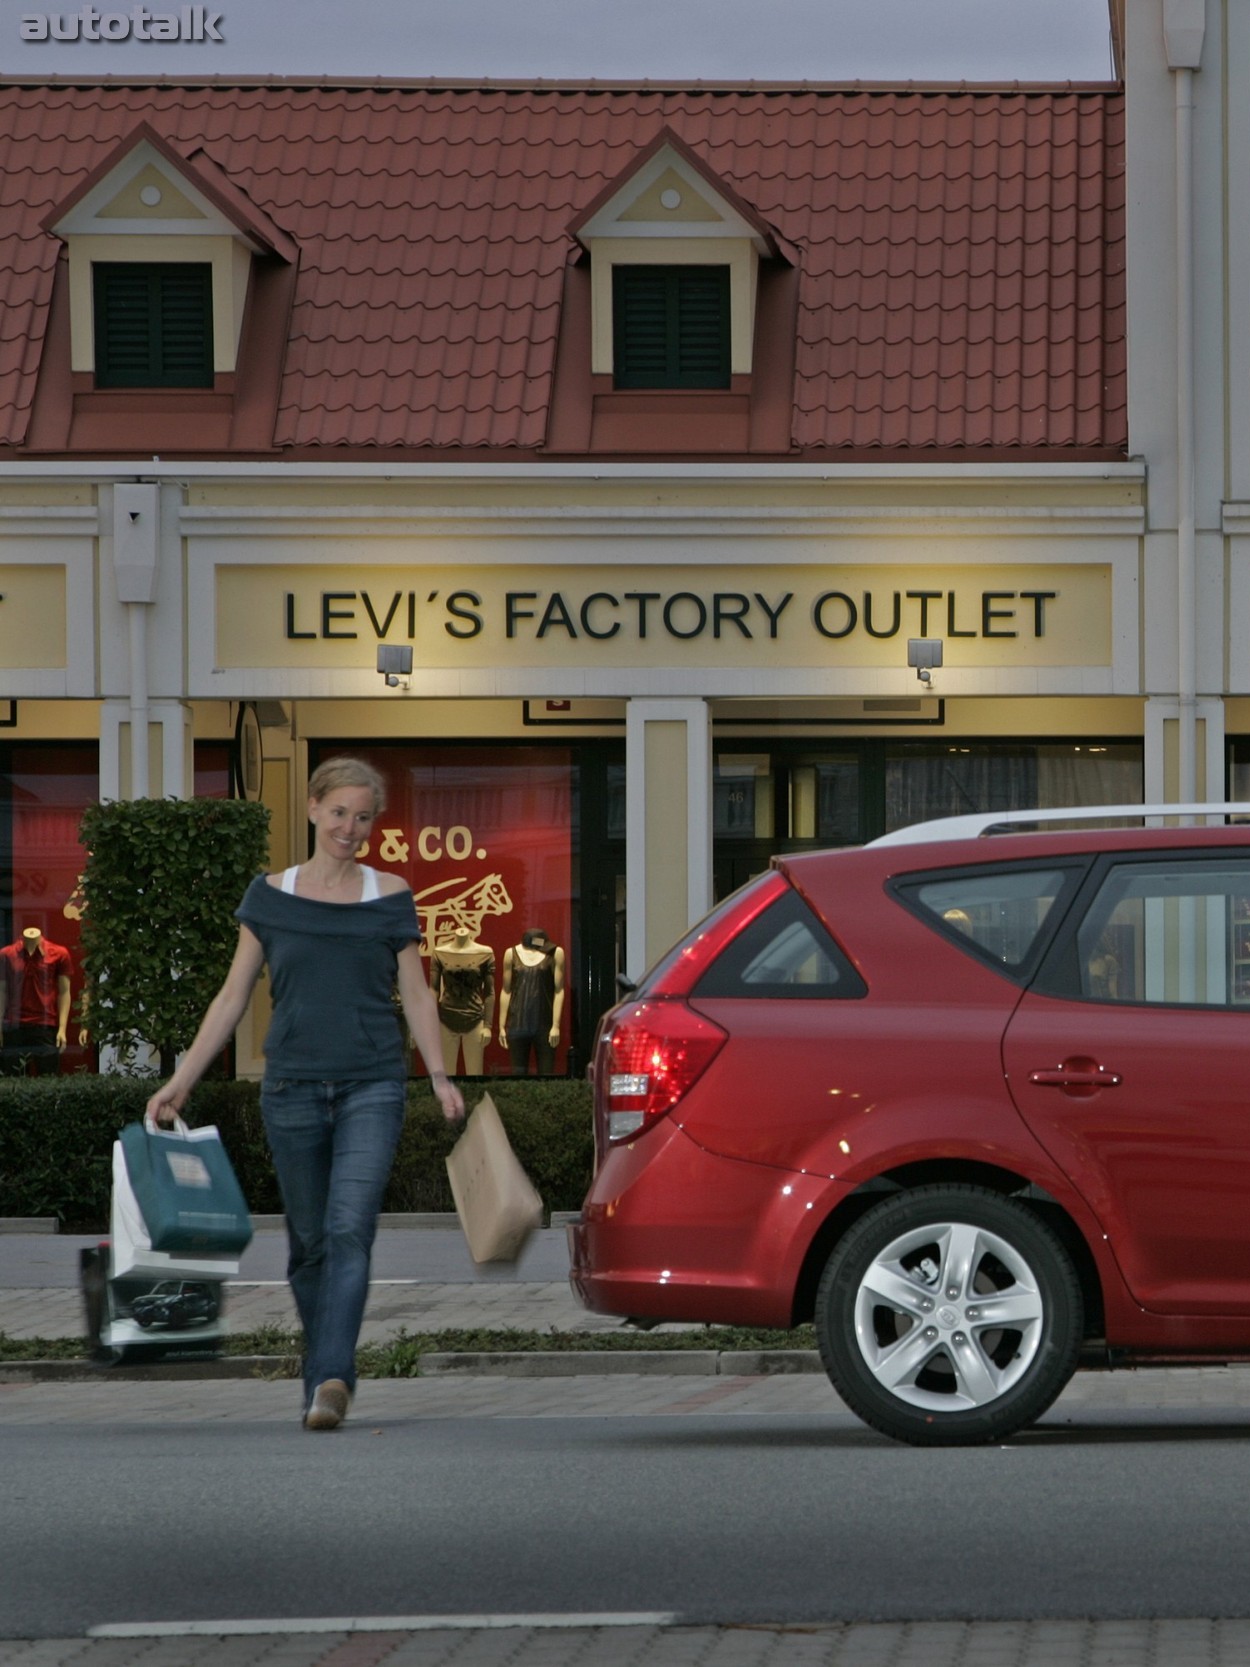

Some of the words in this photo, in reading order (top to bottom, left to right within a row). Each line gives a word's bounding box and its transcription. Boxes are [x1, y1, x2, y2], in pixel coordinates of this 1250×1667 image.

[505, 591, 795, 640] FACTORY
[812, 590, 1057, 639] OUTLET
[728, 791, 744, 804] 46
[417, 825, 487, 862] CO.
